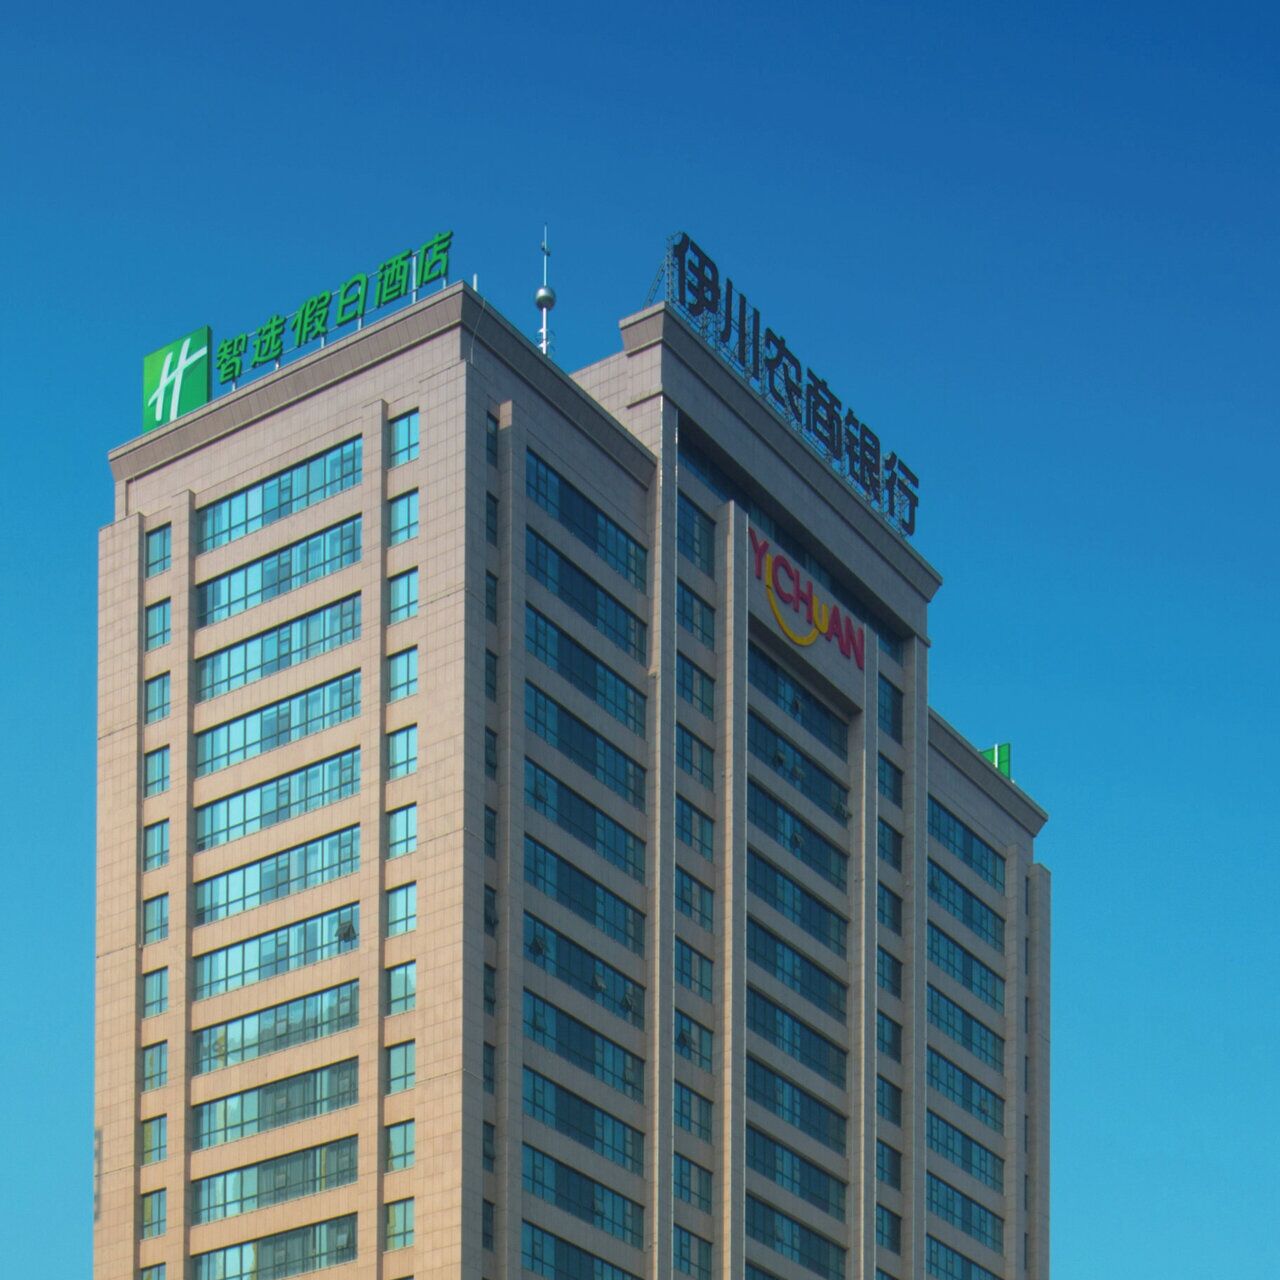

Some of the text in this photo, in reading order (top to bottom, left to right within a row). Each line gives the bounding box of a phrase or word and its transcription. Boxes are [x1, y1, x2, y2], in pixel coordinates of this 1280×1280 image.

[216, 230, 454, 385] 智选假日酒店
[673, 231, 919, 537] 伊川农商银行
